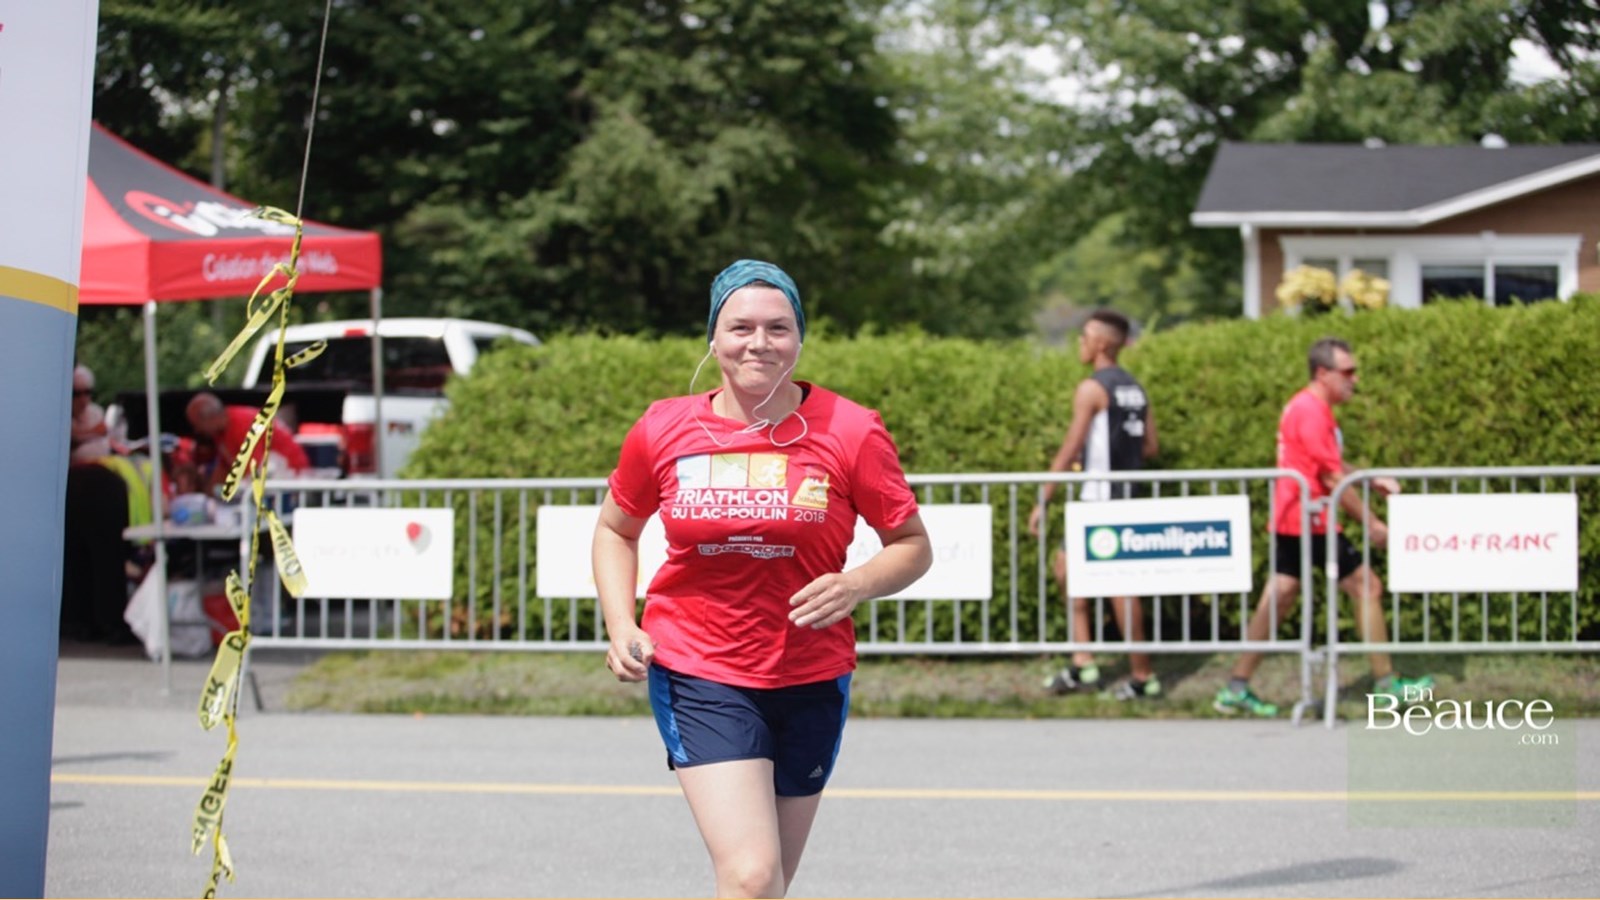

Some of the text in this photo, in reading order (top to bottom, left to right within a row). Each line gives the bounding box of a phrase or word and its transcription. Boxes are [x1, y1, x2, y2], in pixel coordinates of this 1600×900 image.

[674, 490, 788, 505] TRIATHLON
[691, 507, 787, 520] LAC-POULIN
[794, 510, 825, 523] 2018
[1121, 526, 1228, 556] familiprix
